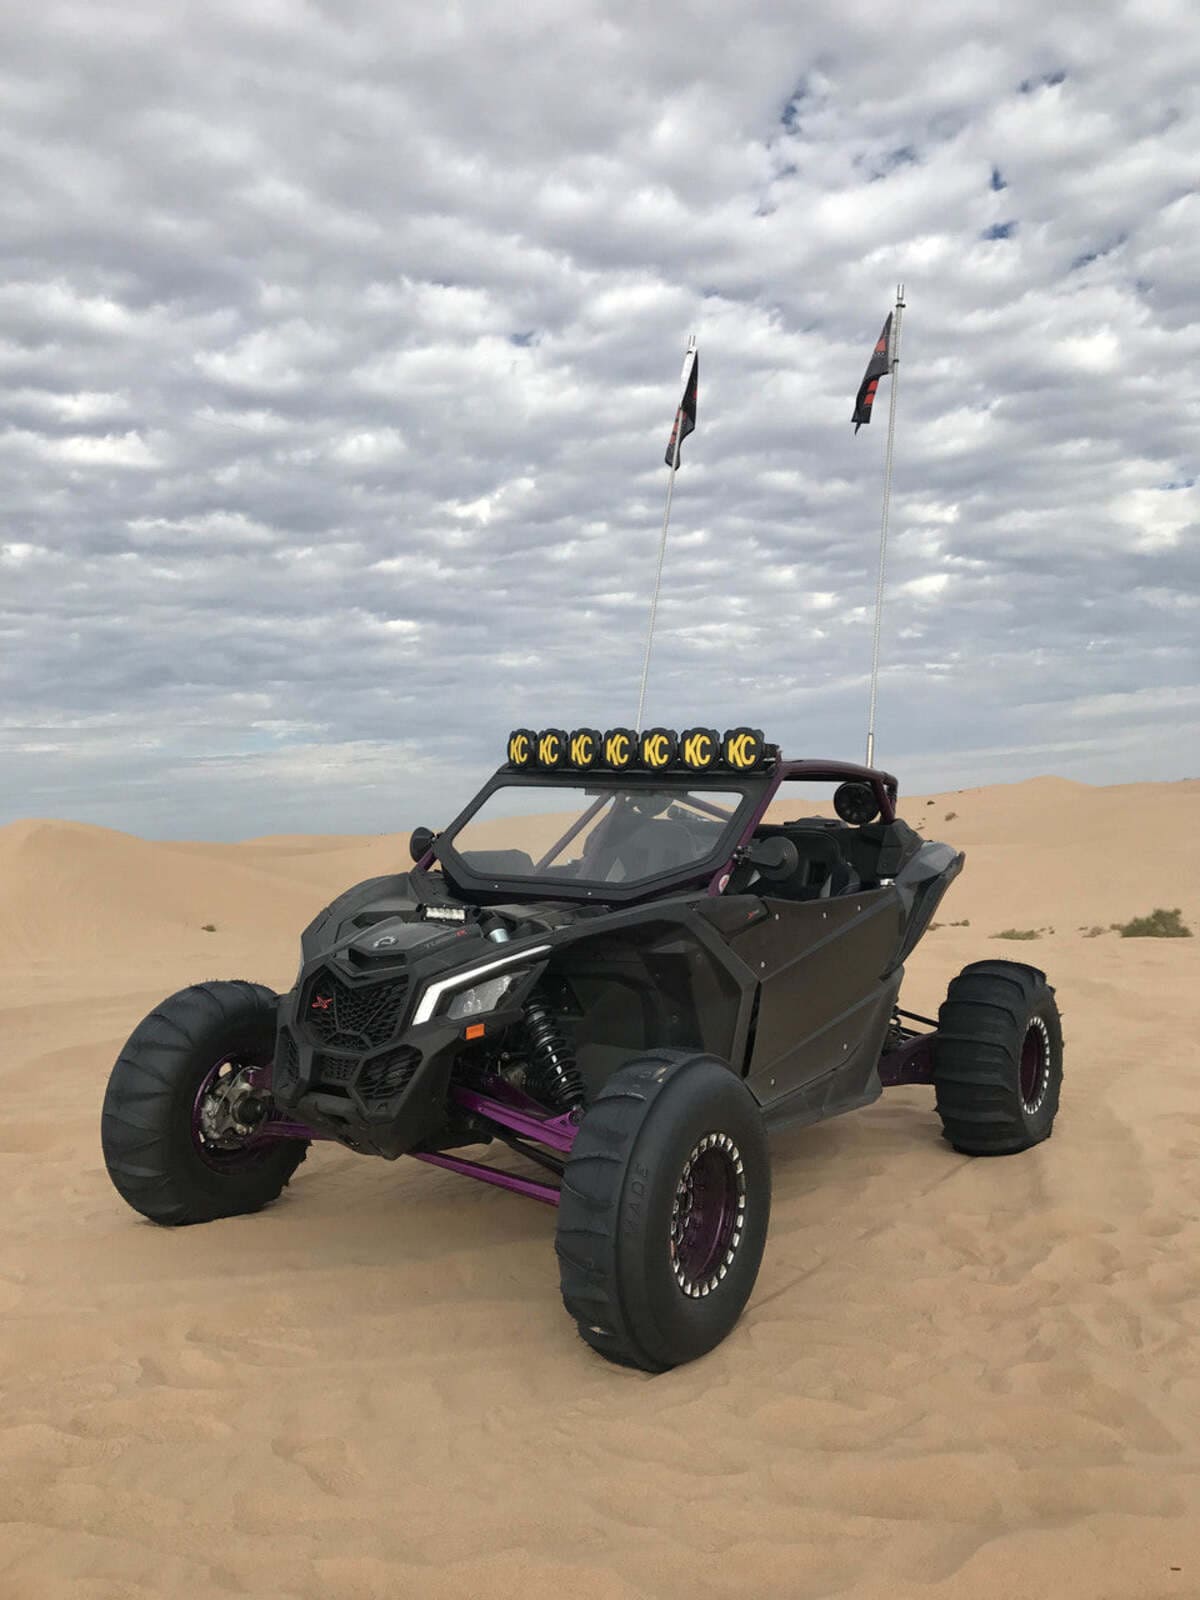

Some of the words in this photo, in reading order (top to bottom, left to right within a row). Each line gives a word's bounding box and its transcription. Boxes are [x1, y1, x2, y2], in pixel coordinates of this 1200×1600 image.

[510, 735, 528, 764] KC
[539, 735, 559, 764] KC
[571, 735, 592, 764] KC
[606, 735, 629, 766] KC
[644, 734, 669, 766] KC
[685, 734, 711, 767] KC
[728, 734, 756, 767] KC
